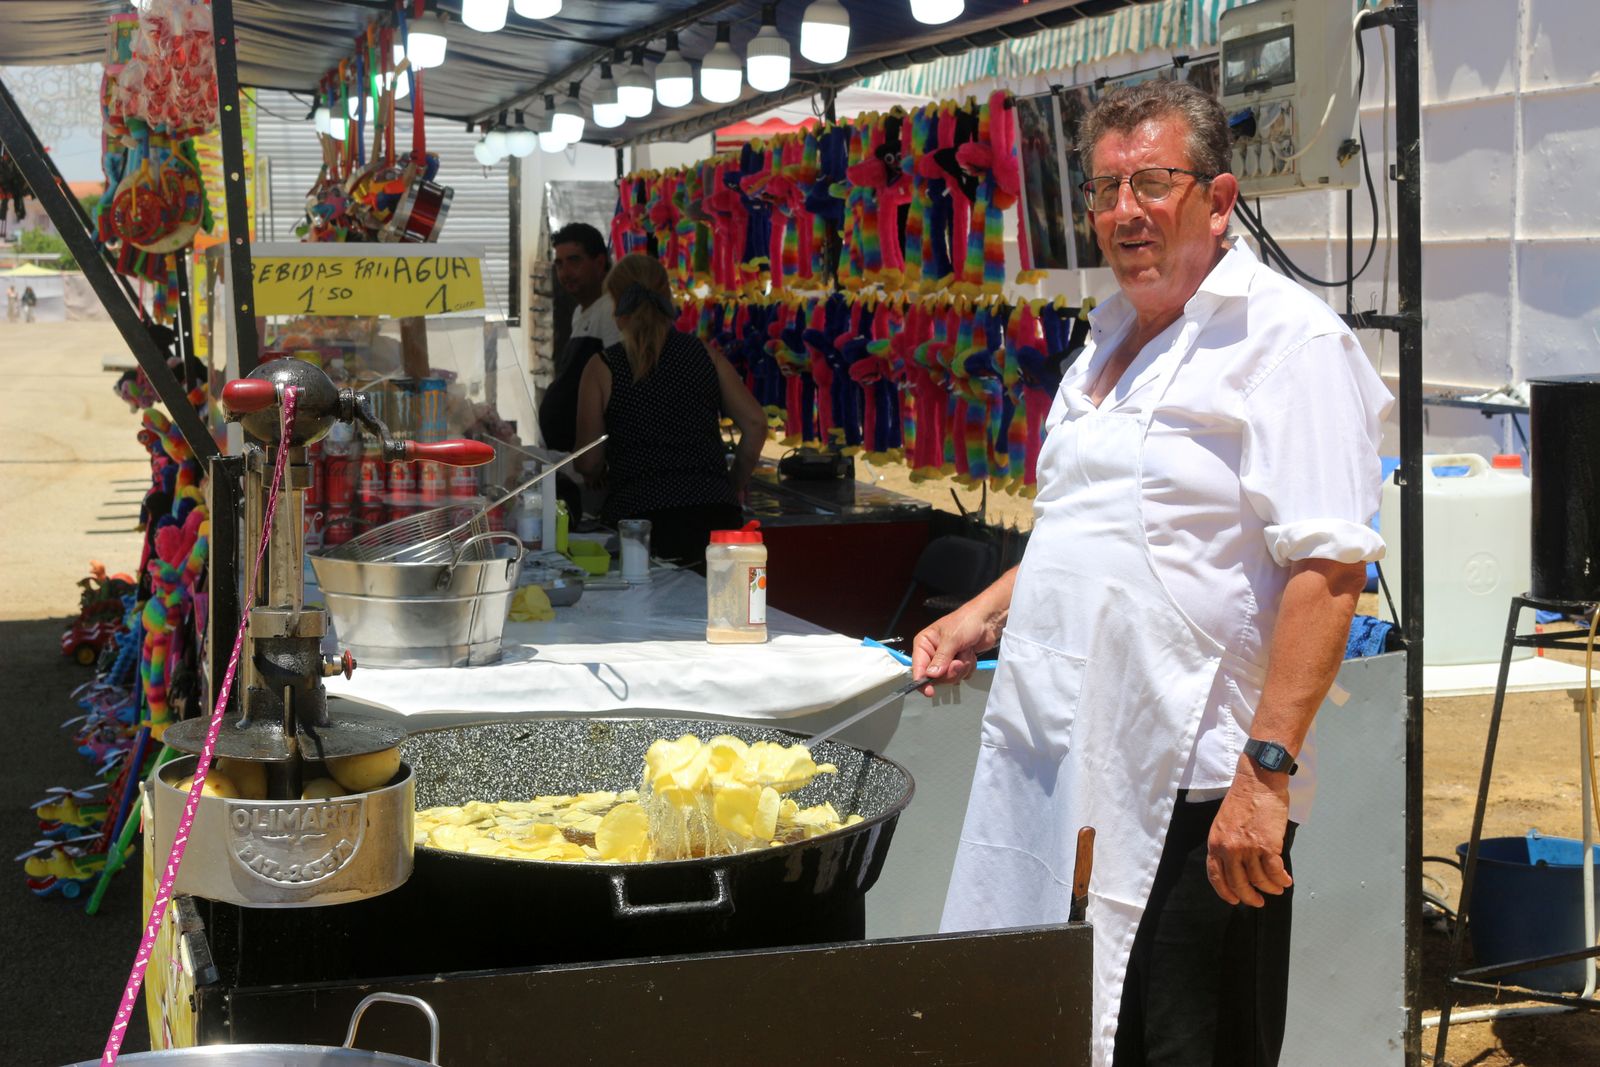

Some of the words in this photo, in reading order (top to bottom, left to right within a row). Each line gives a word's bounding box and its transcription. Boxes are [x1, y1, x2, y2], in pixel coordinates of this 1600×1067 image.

[394, 257, 470, 283] AGUA
[425, 284, 452, 313] 1
[232, 803, 358, 832] OLIMART
